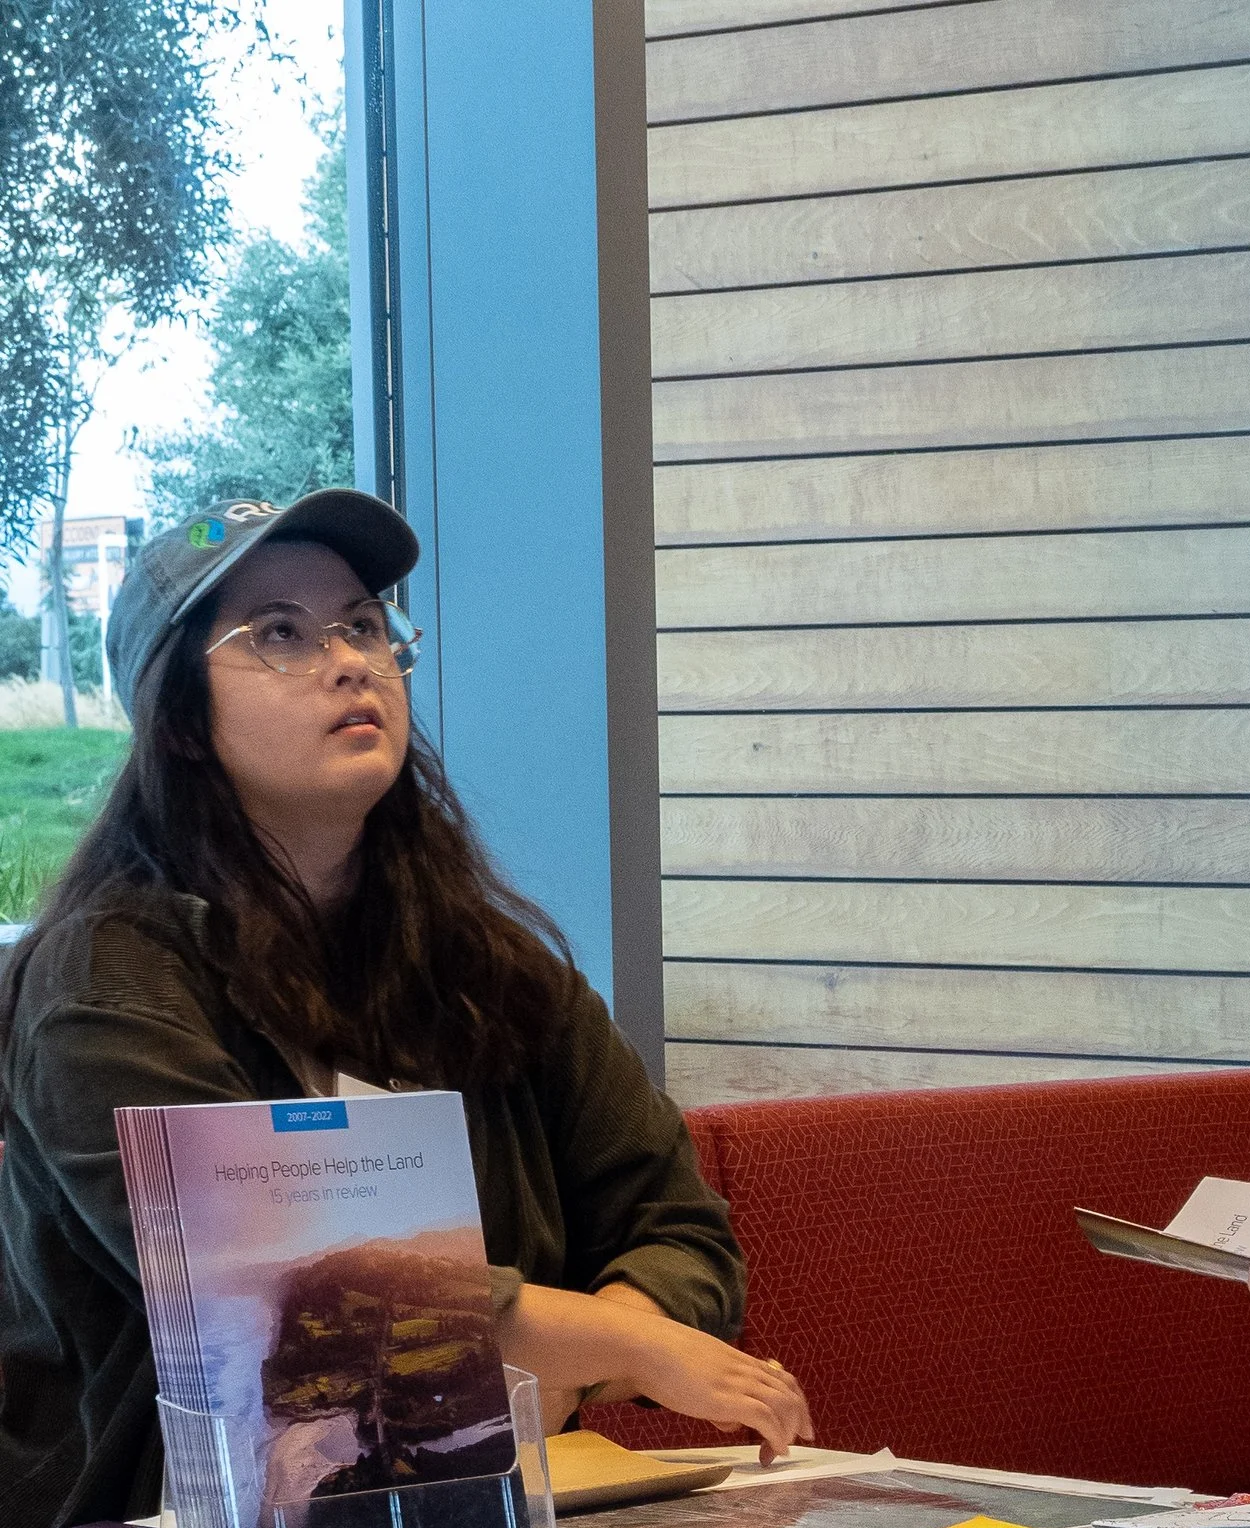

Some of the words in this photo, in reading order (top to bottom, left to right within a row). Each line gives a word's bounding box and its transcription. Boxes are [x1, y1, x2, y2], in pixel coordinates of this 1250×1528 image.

[215, 1163, 269, 1183] Helping
[271, 1160, 321, 1180] People
[324, 1156, 358, 1176] Help
[361, 1154, 384, 1172] the
[387, 1152, 424, 1171] Land
[269, 1188, 283, 1204] 15
[285, 1188, 319, 1207] years
[322, 1187, 333, 1200] in
[335, 1184, 378, 1200] review
[1219, 1214, 1248, 1237] Land
